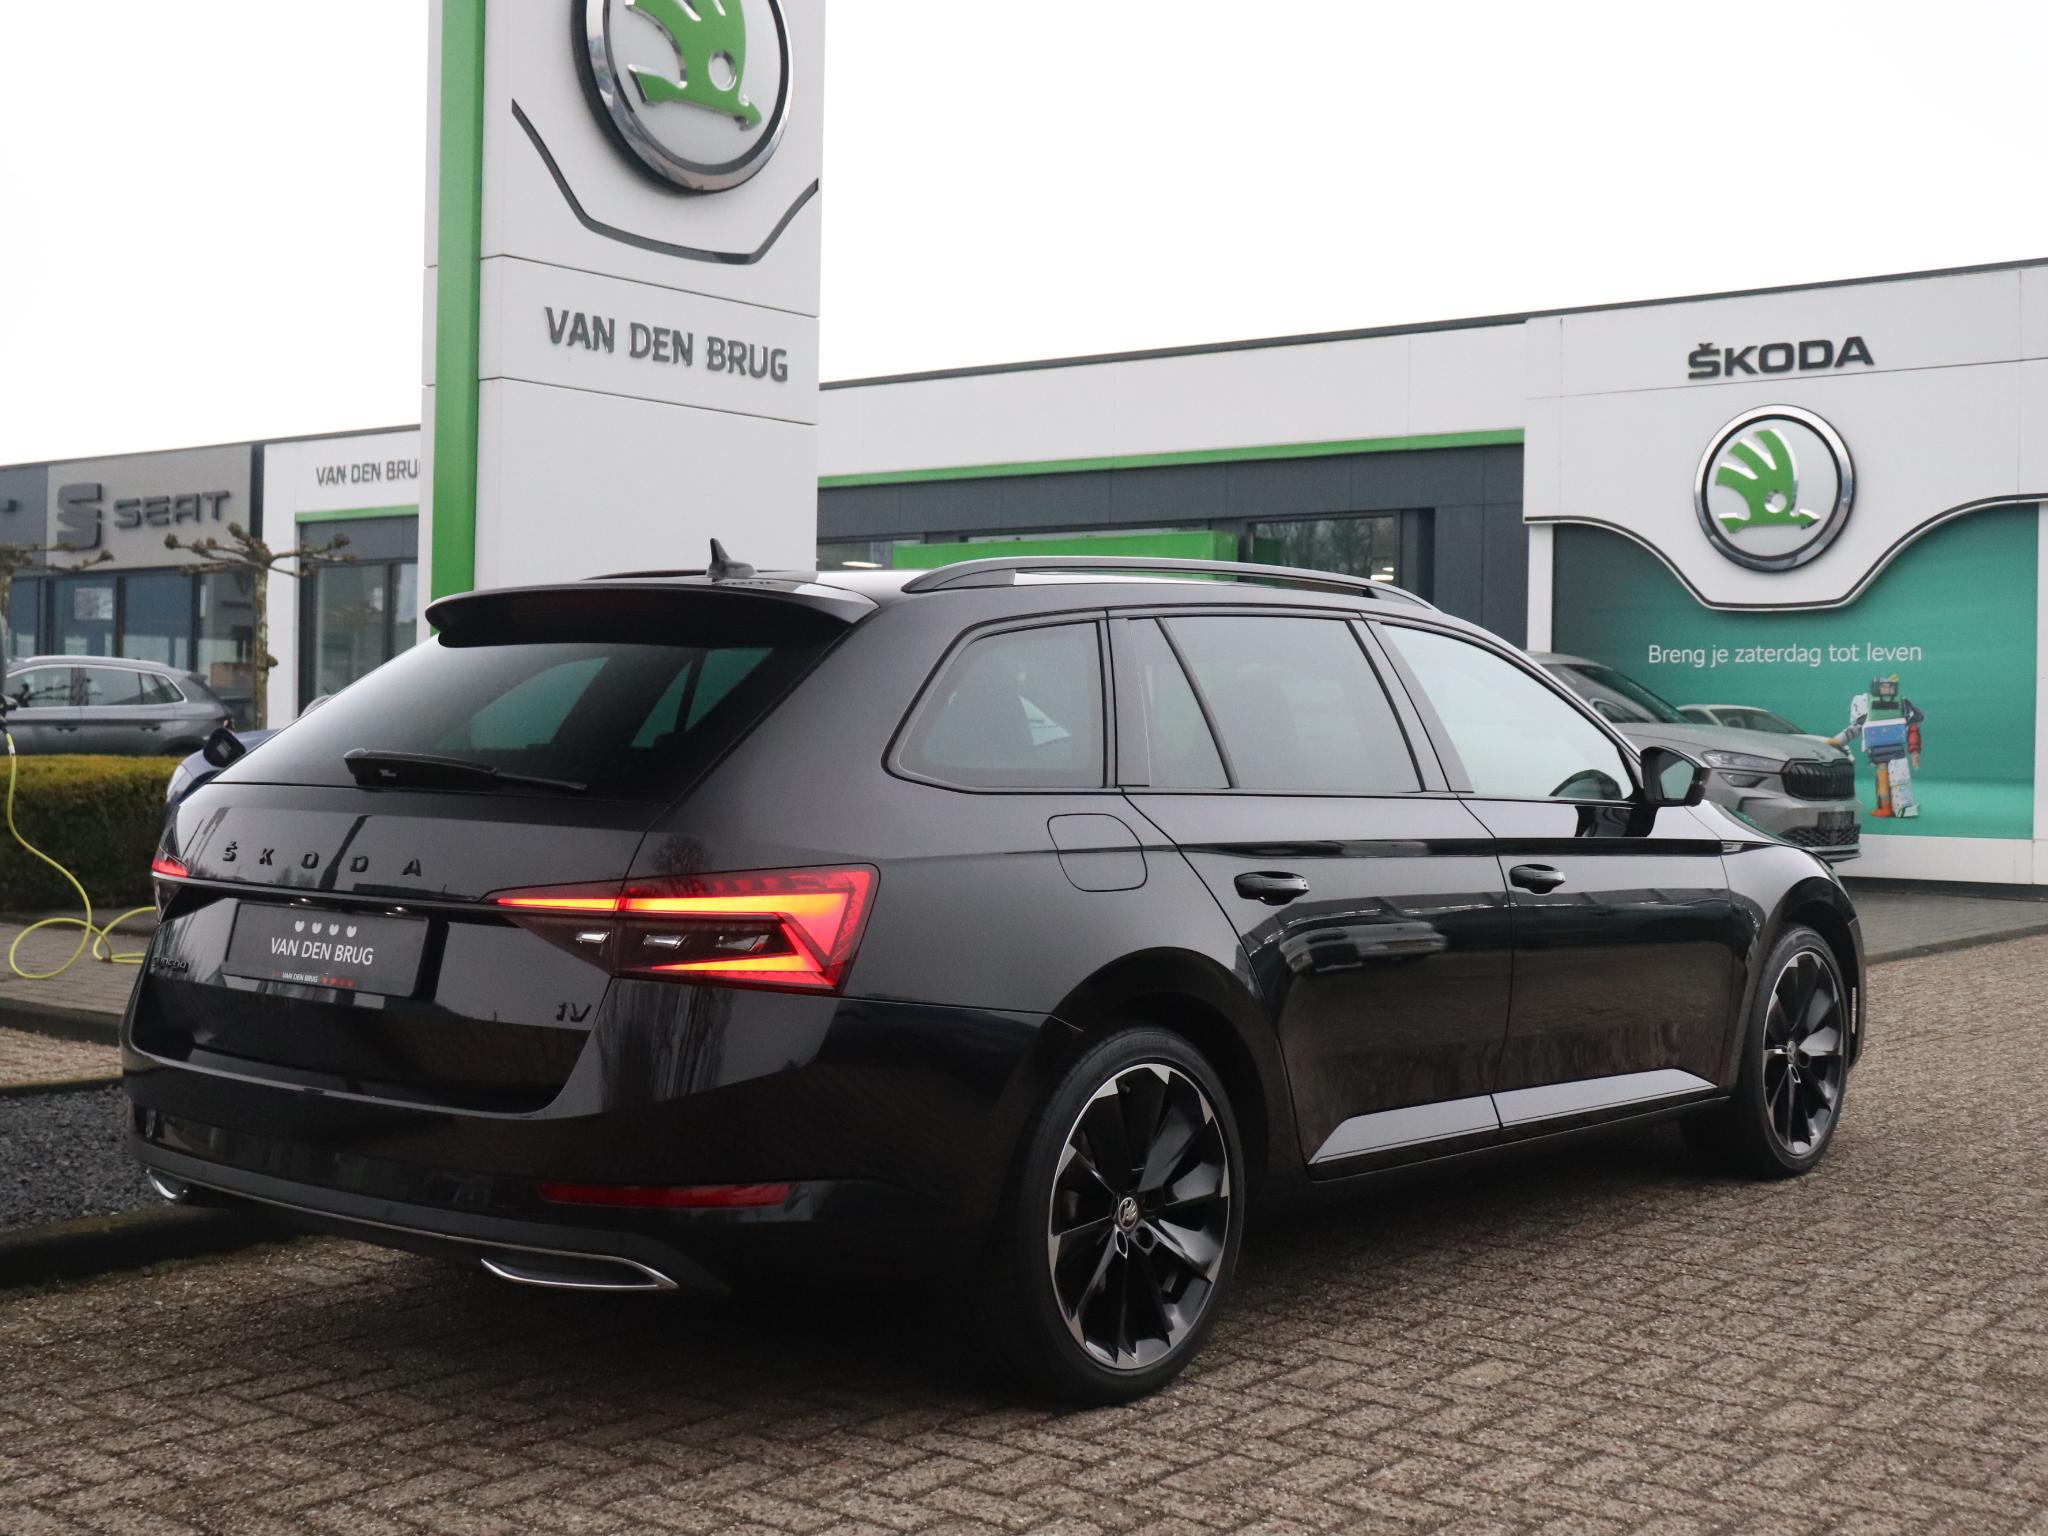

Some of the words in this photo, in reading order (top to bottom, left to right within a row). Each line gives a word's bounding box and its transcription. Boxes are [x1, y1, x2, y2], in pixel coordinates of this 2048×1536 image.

[544, 306, 615, 354] VAN
[629, 321, 694, 367] DEN
[706, 335, 789, 383] BRUG
[1688, 336, 1875, 379] ŠKODA
[316, 465, 347, 486] VAN
[351, 462, 382, 484] DEN
[386, 458, 420, 481] BRU
[113, 490, 231, 529] SEAT
[1648, 644, 1705, 668] Breng
[1710, 644, 1729, 668] je
[1735, 643, 1822, 667] zaterdag
[1828, 644, 1860, 663] tot
[1866, 642, 1922, 662] leven
[271, 937, 299, 957] VAN
[301, 941, 332, 961] DEN
[334, 944, 374, 966] BRUG
